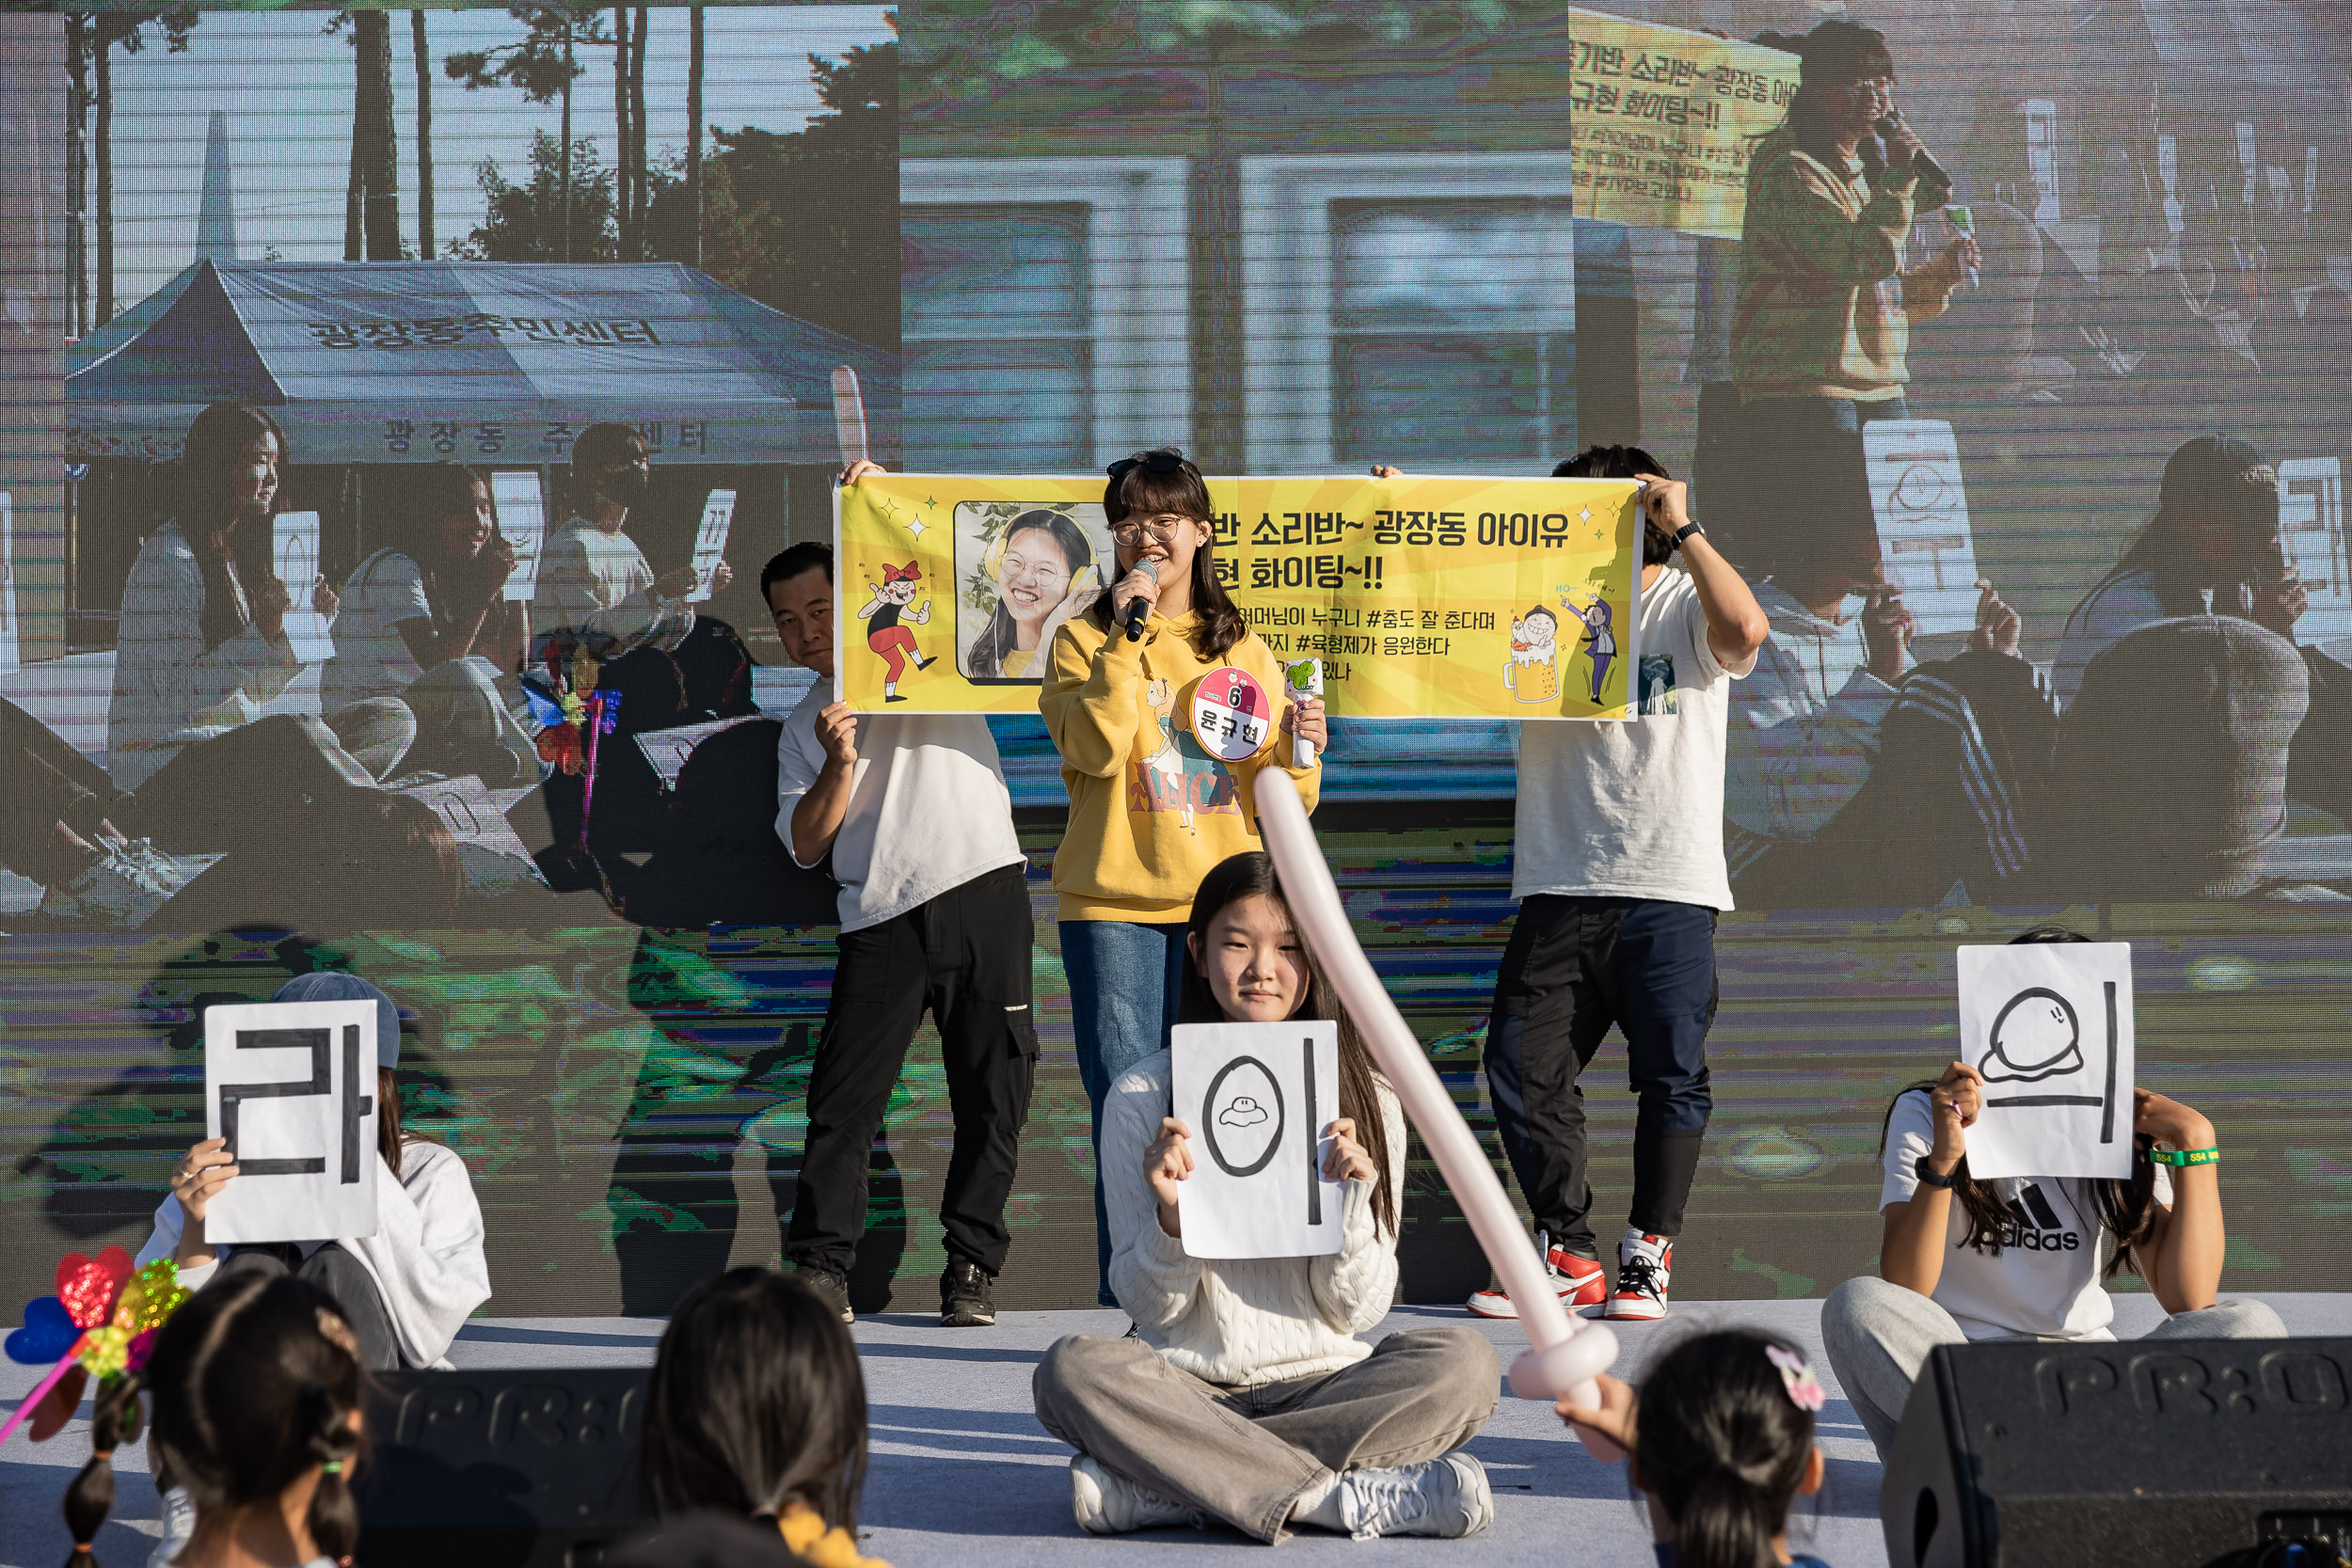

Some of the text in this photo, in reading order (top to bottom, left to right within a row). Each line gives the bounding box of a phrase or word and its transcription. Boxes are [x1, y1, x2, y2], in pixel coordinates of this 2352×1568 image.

[1569, 40, 1625, 75] 기반
[1714, 66, 1769, 103] 광장동
[1570, 80, 1619, 114] 규현
[308, 313, 660, 349] 광장동주민센터
[384, 420, 707, 455] 광장동 주센터
[1214, 510, 1568, 547] 반 소리반~ 광장동 아이유
[1213, 555, 1383, 591] 현 화이팅~!!
[1237, 607, 1495, 630] 어머님이 누구니 #춤도 잘 춘다며
[1262, 633, 1451, 656] 까지 #육형제가 응원한다
[1228, 686, 1242, 707] 6
[1130, 762, 1242, 816] ALICE
[219, 1023, 373, 1185] 라
[1201, 1037, 1322, 1226] 이
[2155, 1153, 2172, 1164] 554
[2189, 1151, 2206, 1163] 554
